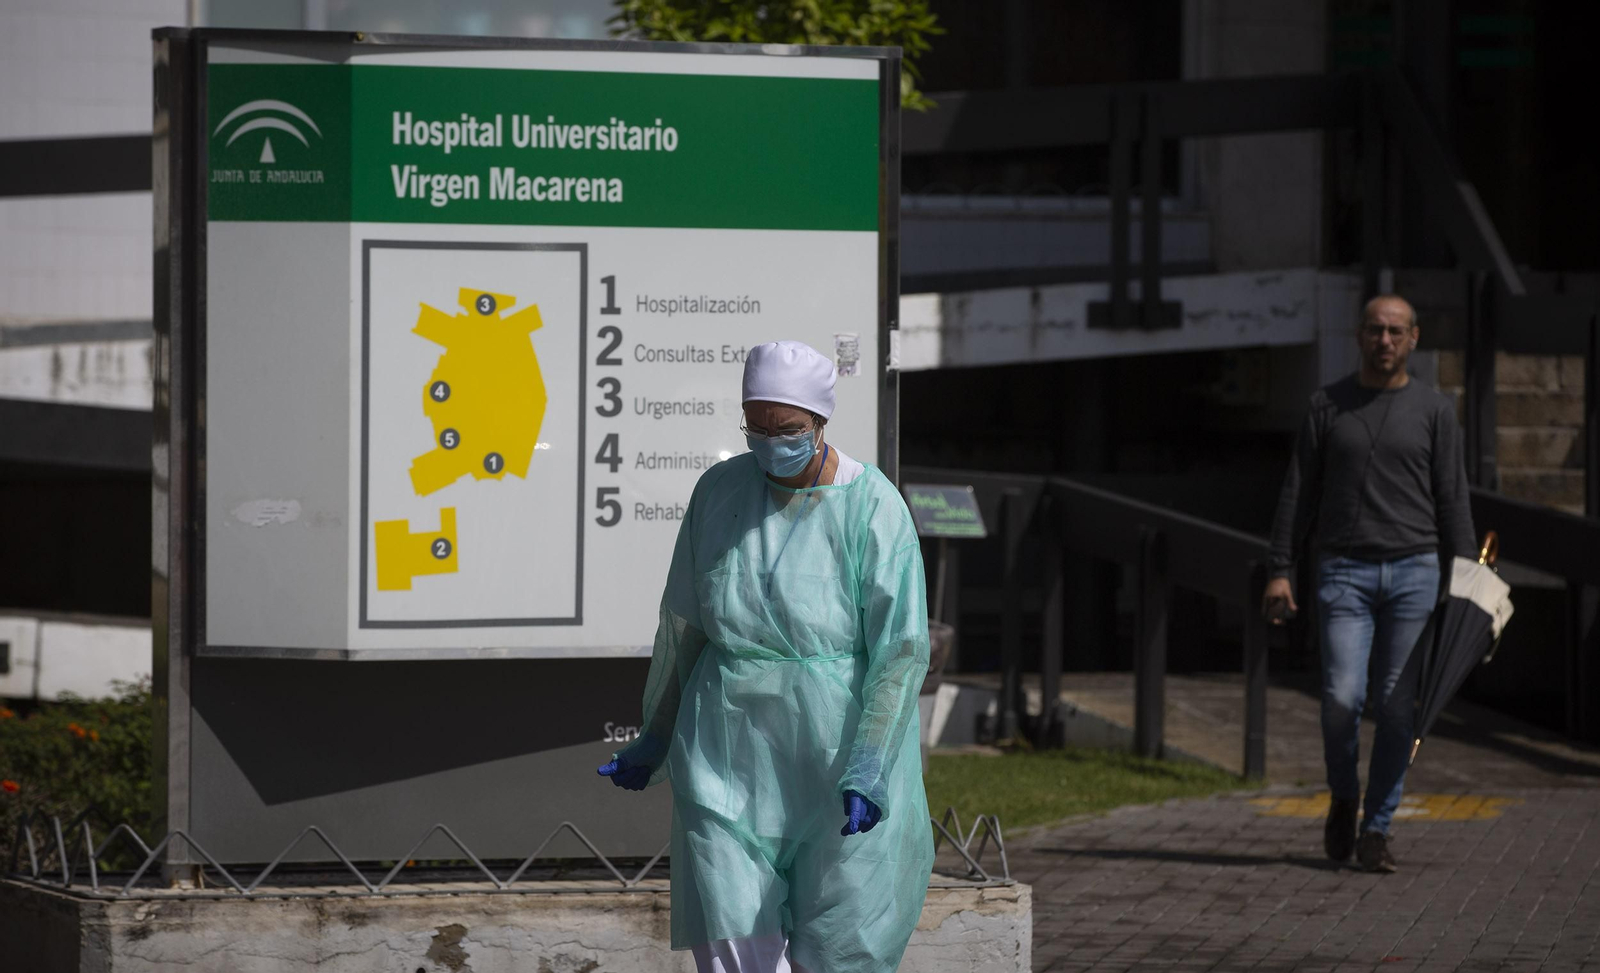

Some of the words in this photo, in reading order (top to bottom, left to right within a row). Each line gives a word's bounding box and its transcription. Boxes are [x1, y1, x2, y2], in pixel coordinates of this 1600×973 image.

[391, 111, 502, 154] Hospital
[511, 115, 679, 152] Universitario
[211, 169, 245, 183] JUNTA
[249, 169, 262, 183] DE
[266, 169, 324, 183] ANDALUCIA
[391, 164, 480, 207] Virgen
[490, 167, 623, 203] Macarena
[480, 297, 490, 312] 3
[600, 275, 621, 315] 1
[636, 295, 761, 317] Hospitalización
[596, 325, 623, 366] 2
[634, 343, 715, 363] Consultas
[434, 385, 445, 398] 4
[595, 376, 623, 417] 3
[634, 397, 715, 420] Urgencias
[445, 433, 454, 447] 5
[595, 433, 623, 473] 4
[489, 456, 497, 470] 1
[595, 486, 622, 527] 5
[436, 542, 446, 556] 2
